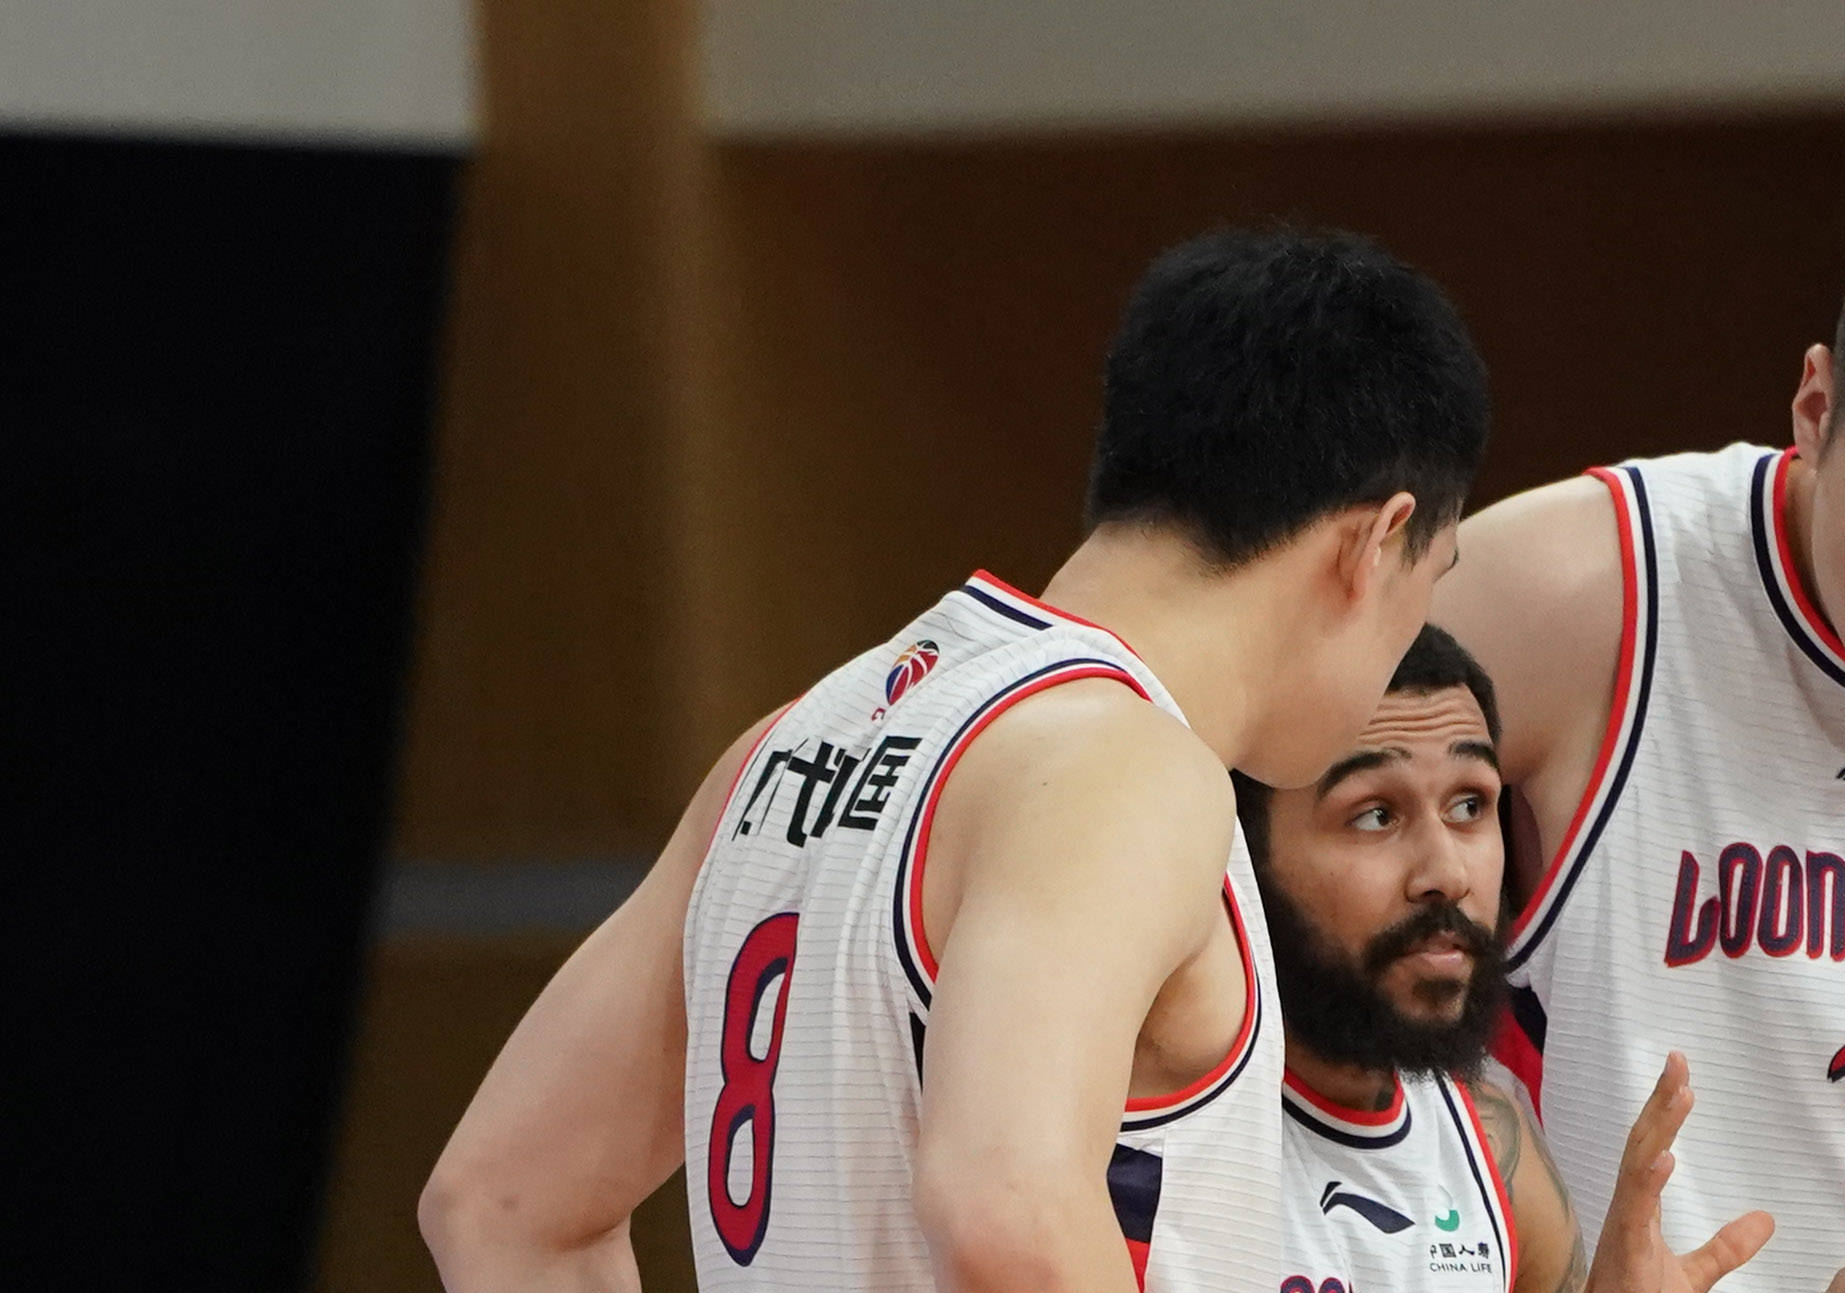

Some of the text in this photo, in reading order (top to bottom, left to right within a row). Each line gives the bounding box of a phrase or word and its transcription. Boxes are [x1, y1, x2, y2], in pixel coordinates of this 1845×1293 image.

[708, 911, 800, 1267] 8
[1430, 1262, 1492, 1273] CHINA LIFE
